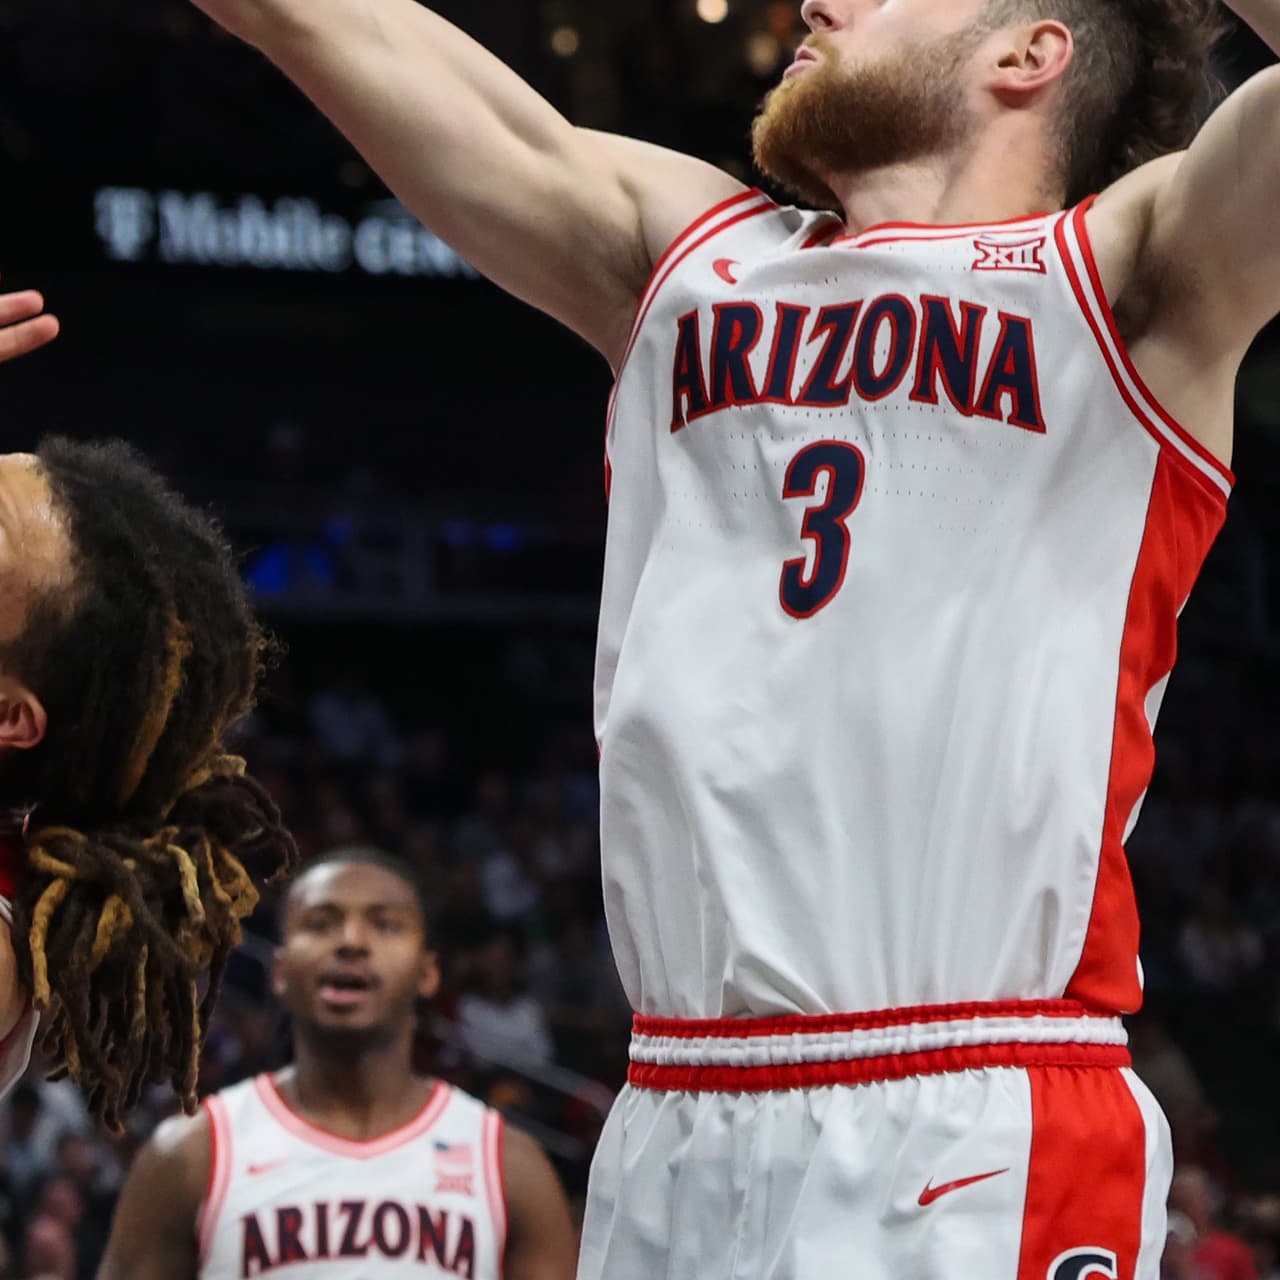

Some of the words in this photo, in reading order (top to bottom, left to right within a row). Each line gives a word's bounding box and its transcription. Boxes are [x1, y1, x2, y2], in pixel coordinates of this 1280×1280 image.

[158, 190, 352, 273] Mobile
[670, 293, 1047, 434] ARIZONA
[779, 440, 866, 620] 3
[241, 1200, 476, 1280] ARIZONA
